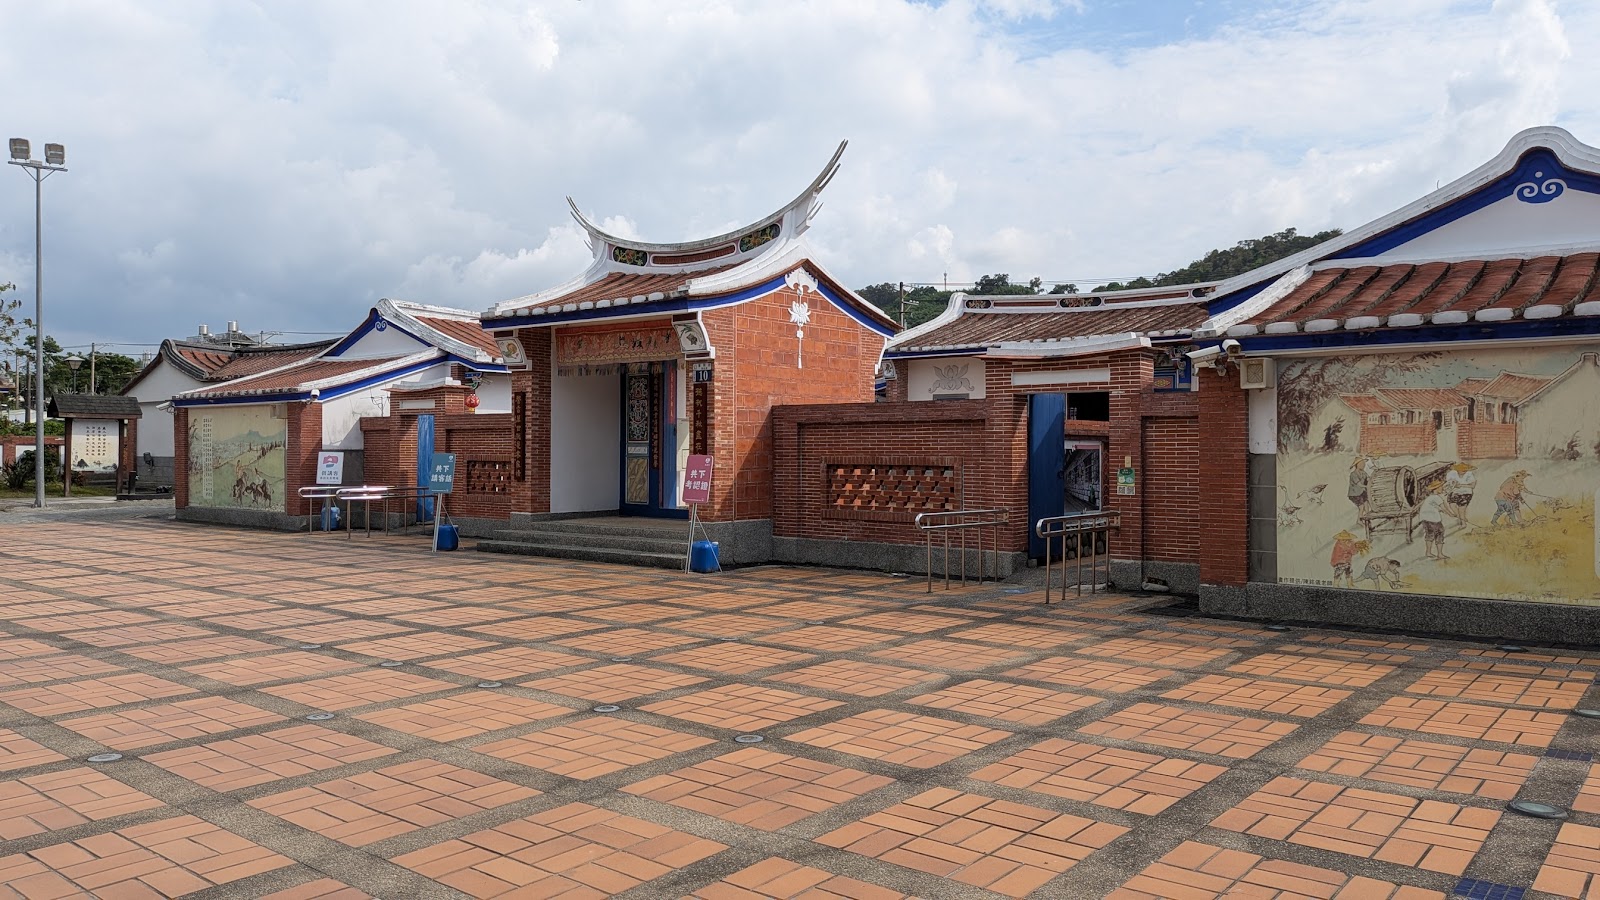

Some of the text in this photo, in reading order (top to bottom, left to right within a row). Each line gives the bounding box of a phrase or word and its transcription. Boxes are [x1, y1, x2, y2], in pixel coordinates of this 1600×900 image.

[698, 370, 708, 381] 10
[436, 465, 450, 473] 共下
[690, 469, 706, 479] 共下
[431, 474, 452, 483] 講客話
[685, 480, 709, 491] 考認證
